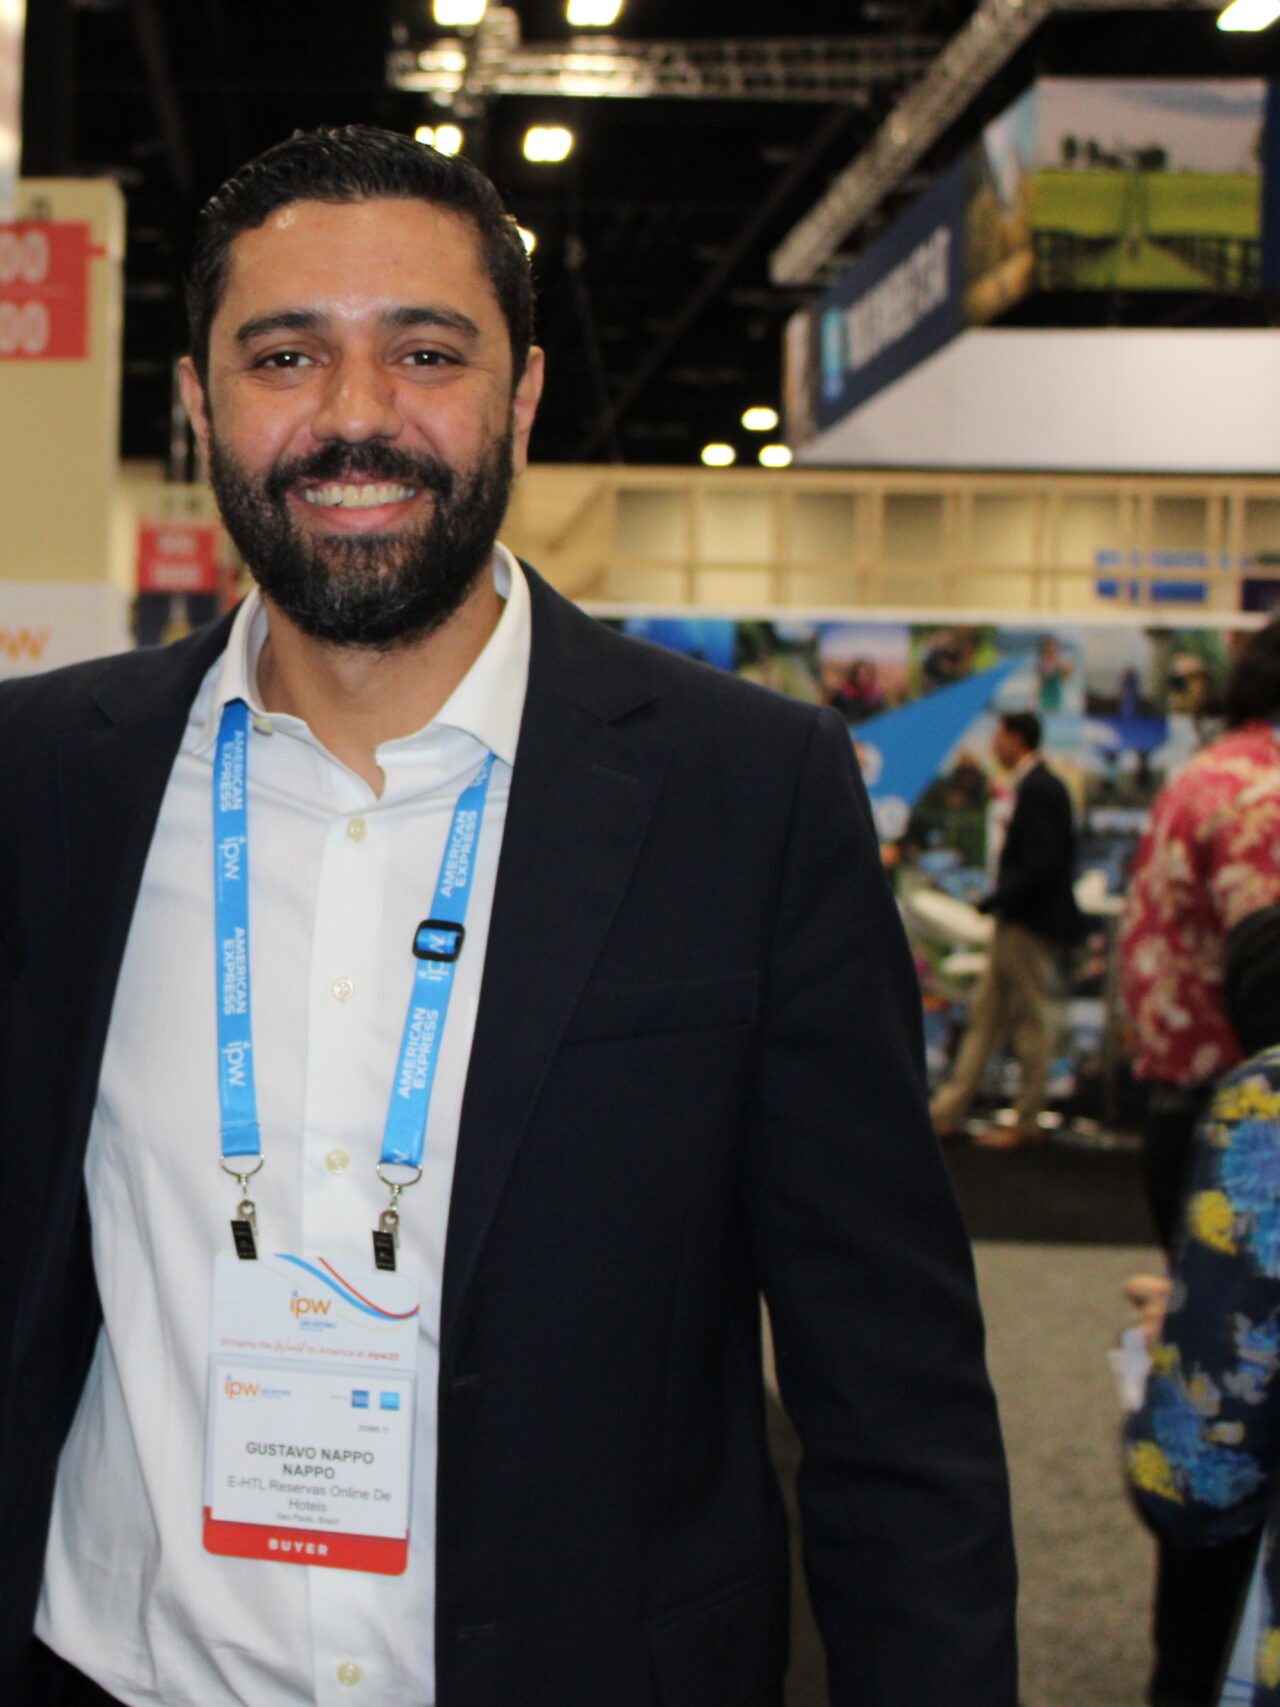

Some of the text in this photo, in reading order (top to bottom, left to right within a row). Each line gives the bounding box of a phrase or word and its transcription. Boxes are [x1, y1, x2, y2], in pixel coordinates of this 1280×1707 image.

[219, 741, 233, 812] EXPRESS
[234, 730, 244, 811] AMERICAN
[218, 836, 247, 881] ipw
[440, 809, 468, 898] AMERICAN
[454, 808, 478, 888] EXPRESS
[222, 938, 236, 1016] EXPRESS
[234, 926, 247, 1015] AMERICAN
[223, 1039, 252, 1088] ipw
[398, 1006, 428, 1099] AMERICAN
[412, 1008, 439, 1089] EXPRESS
[290, 1289, 333, 1319] ipw
[225, 1375, 260, 1400] ipw
[246, 1442, 375, 1464] GUSTAVO NAPPO
[282, 1464, 336, 1480] NAPPO
[227, 1475, 392, 1502] E-HTL Reservas Online De
[268, 1538, 329, 1555] BUYER
